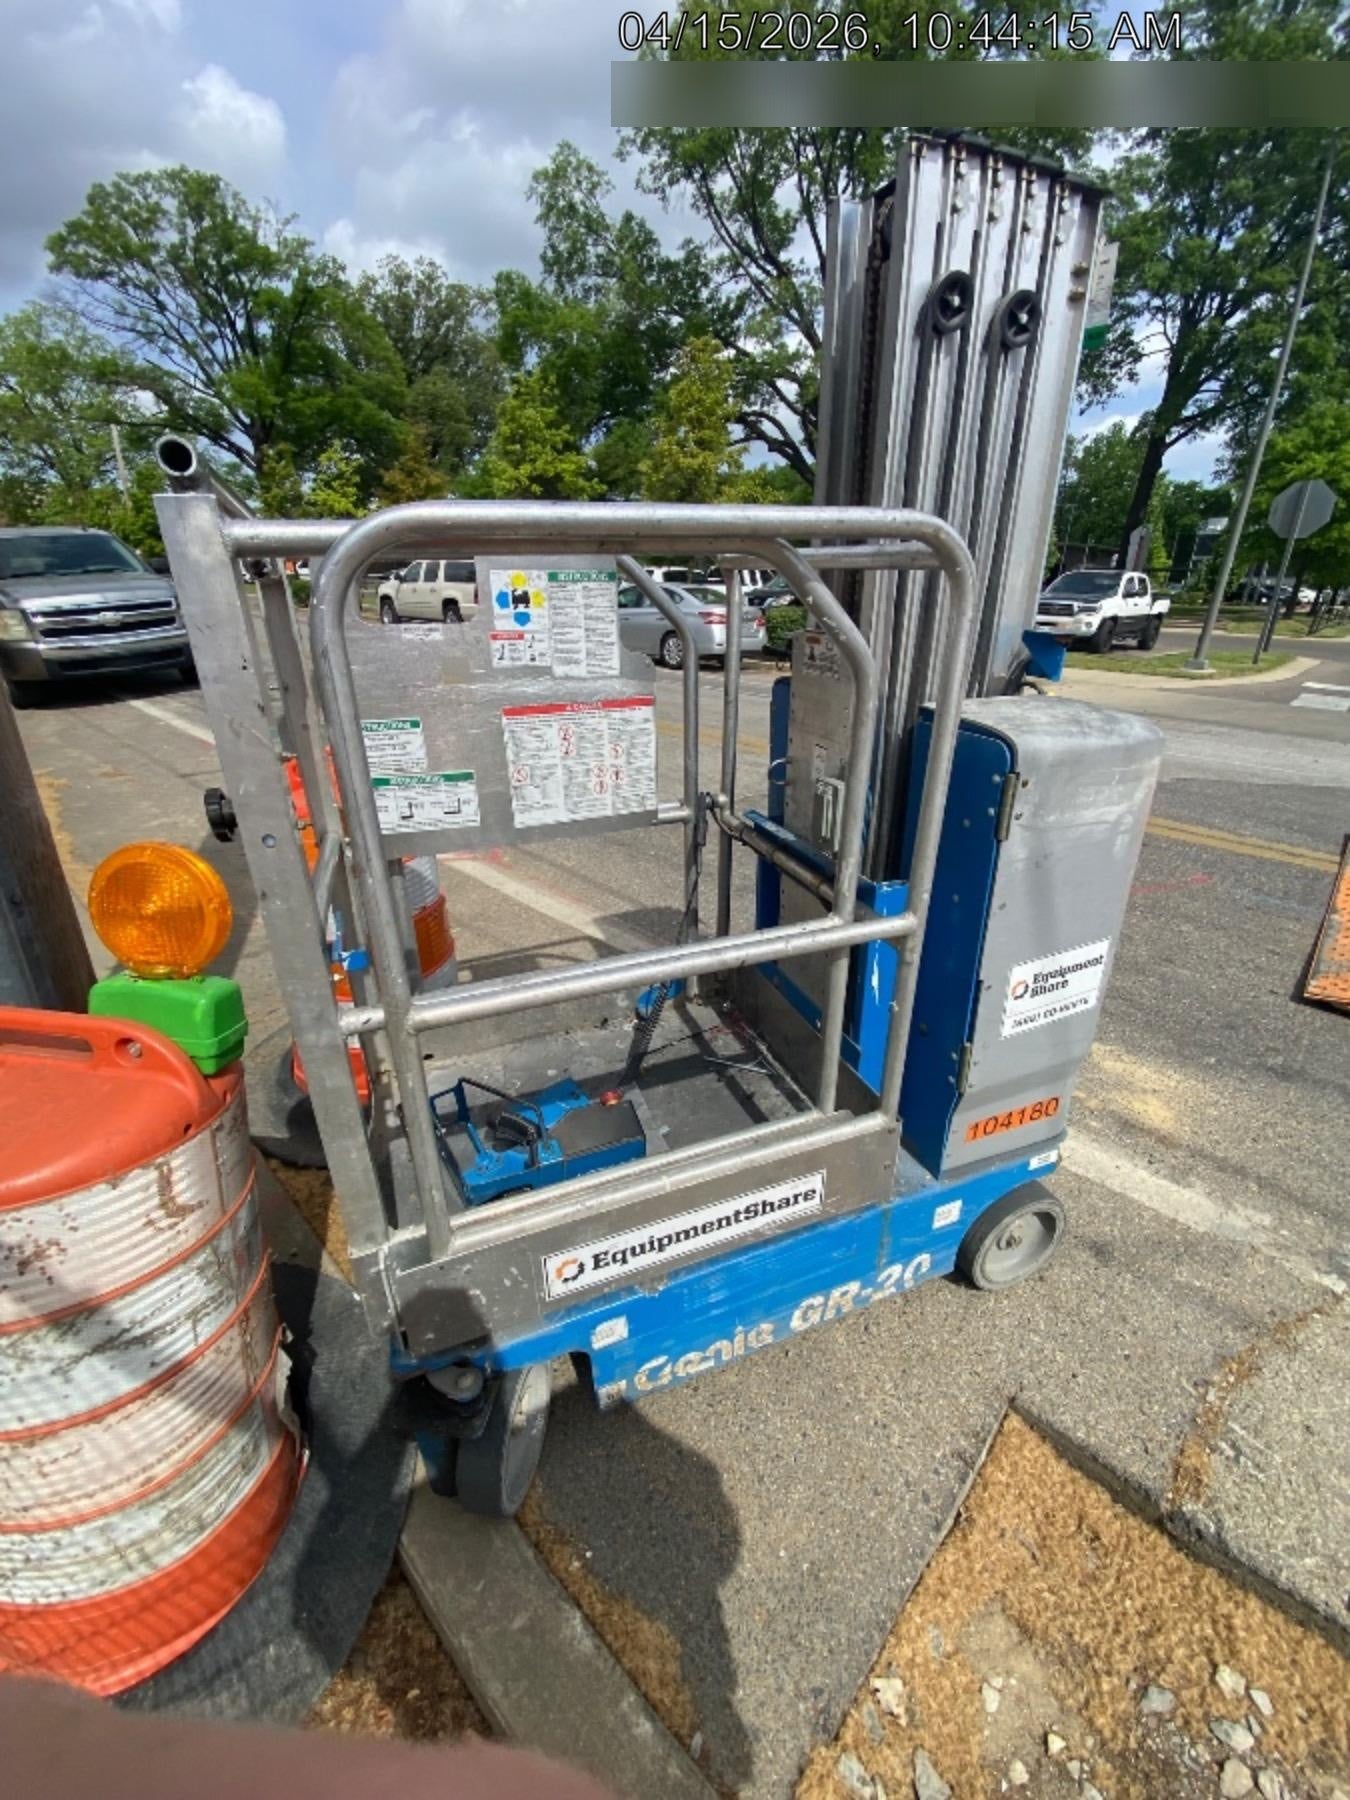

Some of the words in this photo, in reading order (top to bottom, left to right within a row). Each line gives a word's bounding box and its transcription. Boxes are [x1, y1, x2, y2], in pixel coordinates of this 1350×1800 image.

[1029, 979, 1069, 999] Share
[1032, 954, 1105, 985] Equipment
[968, 1096, 1060, 1141] 104180
[591, 1187, 818, 1272] EquipmentShare
[789, 1253, 932, 1332] GR-20
